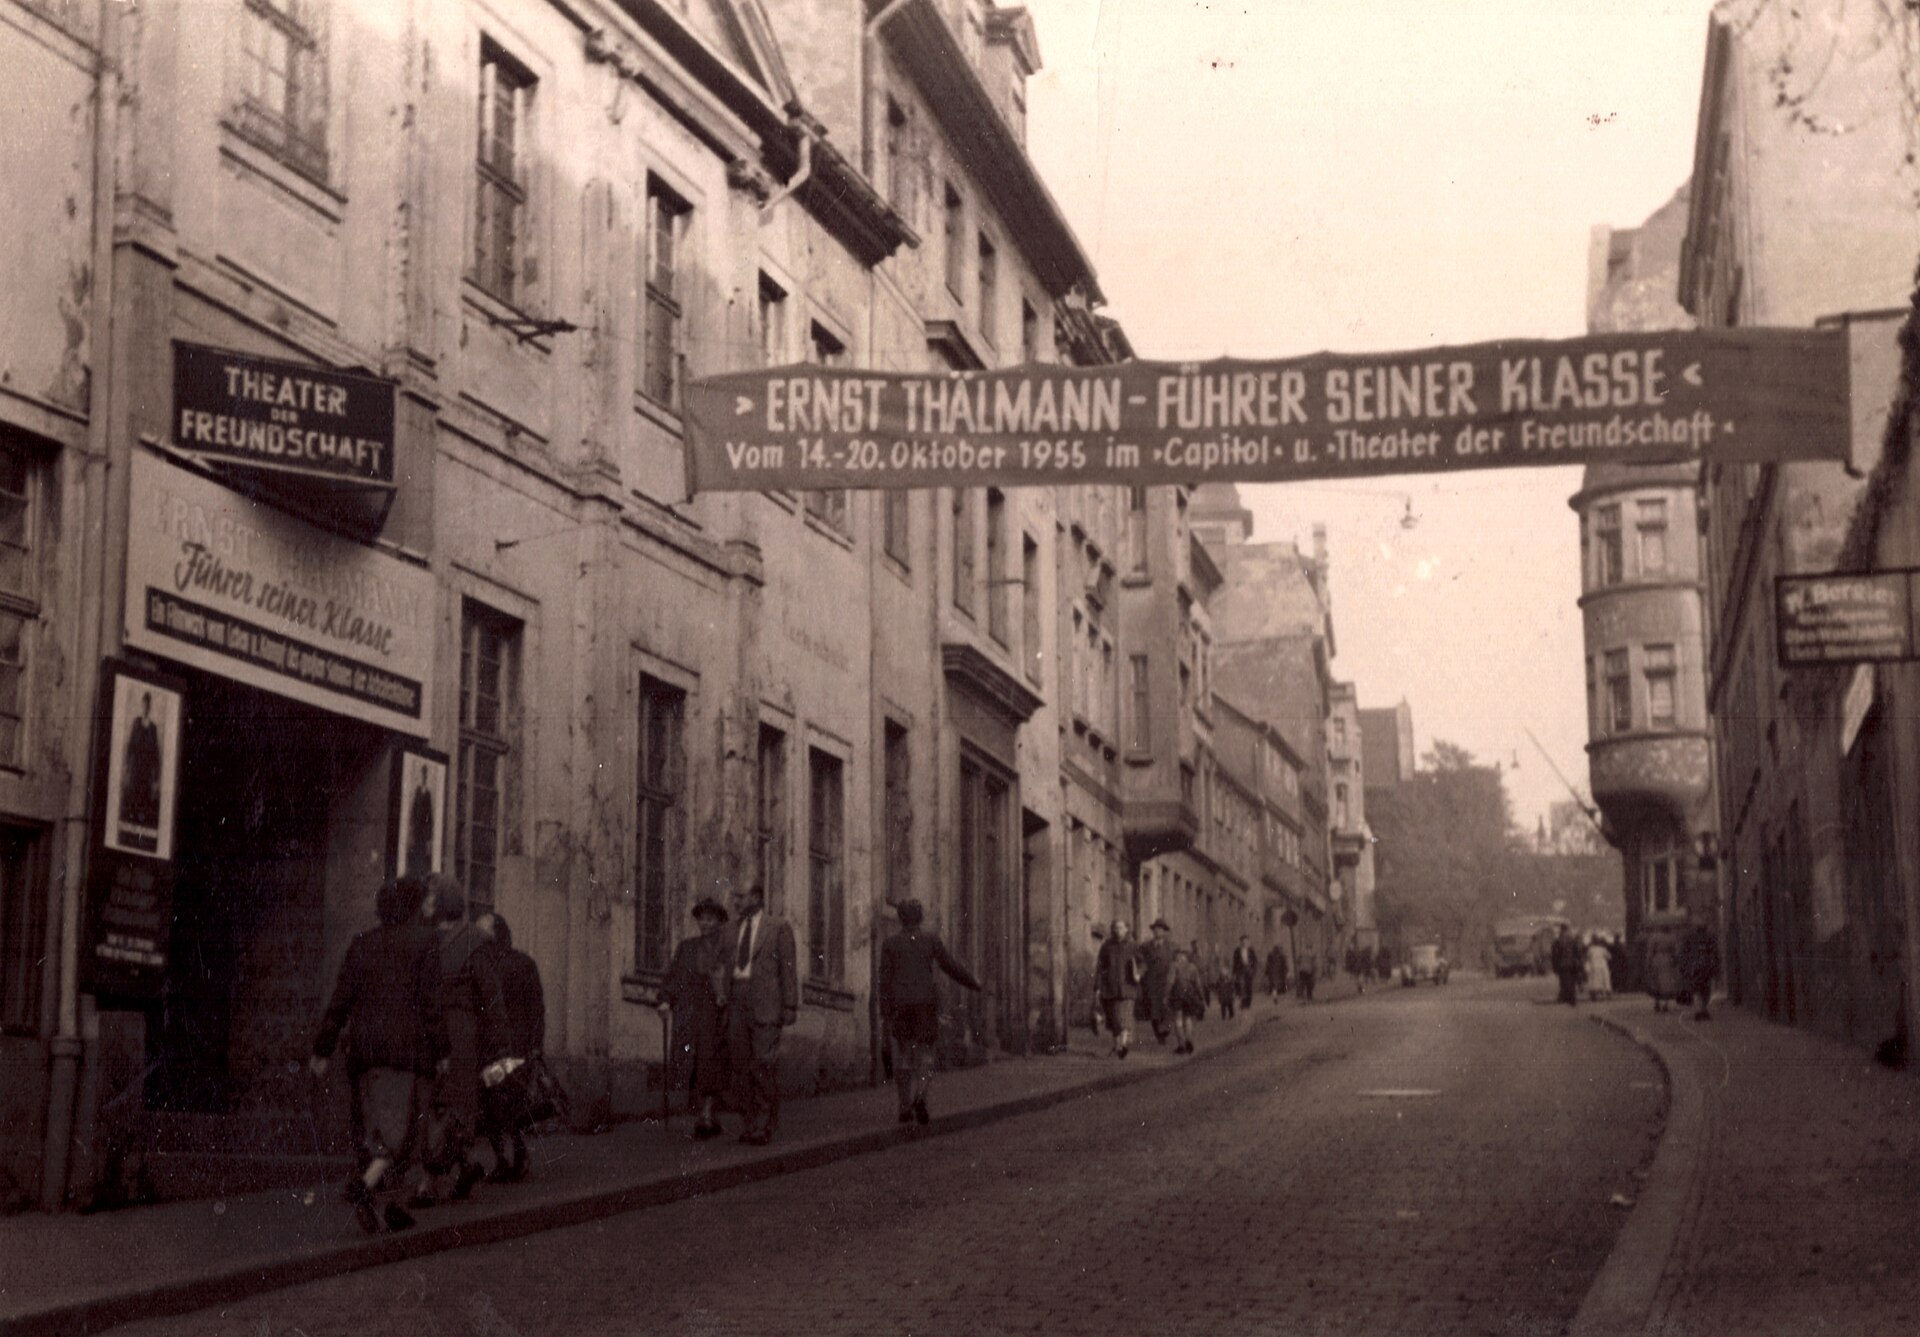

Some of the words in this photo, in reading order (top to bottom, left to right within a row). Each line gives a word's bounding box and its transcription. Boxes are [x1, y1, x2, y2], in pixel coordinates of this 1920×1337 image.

[224, 365, 348, 416] THEATER
[270, 407, 299, 424] DER
[766, 378, 888, 433] ERNST
[901, 370, 1121, 433] THÄLMANN
[1158, 364, 1308, 428] FÜHRER
[1325, 361, 1478, 423] SEINER
[1501, 349, 1667, 412] KLASSE
[180, 408, 384, 472] FREUNDSCHAFT
[726, 441, 784, 470] Vom
[1019, 440, 1087, 469] 1955
[1106, 436, 1140, 467] im
[1294, 440, 1318, 463] u.
[1456, 424, 1504, 455] der
[174, 540, 254, 603] Führer
